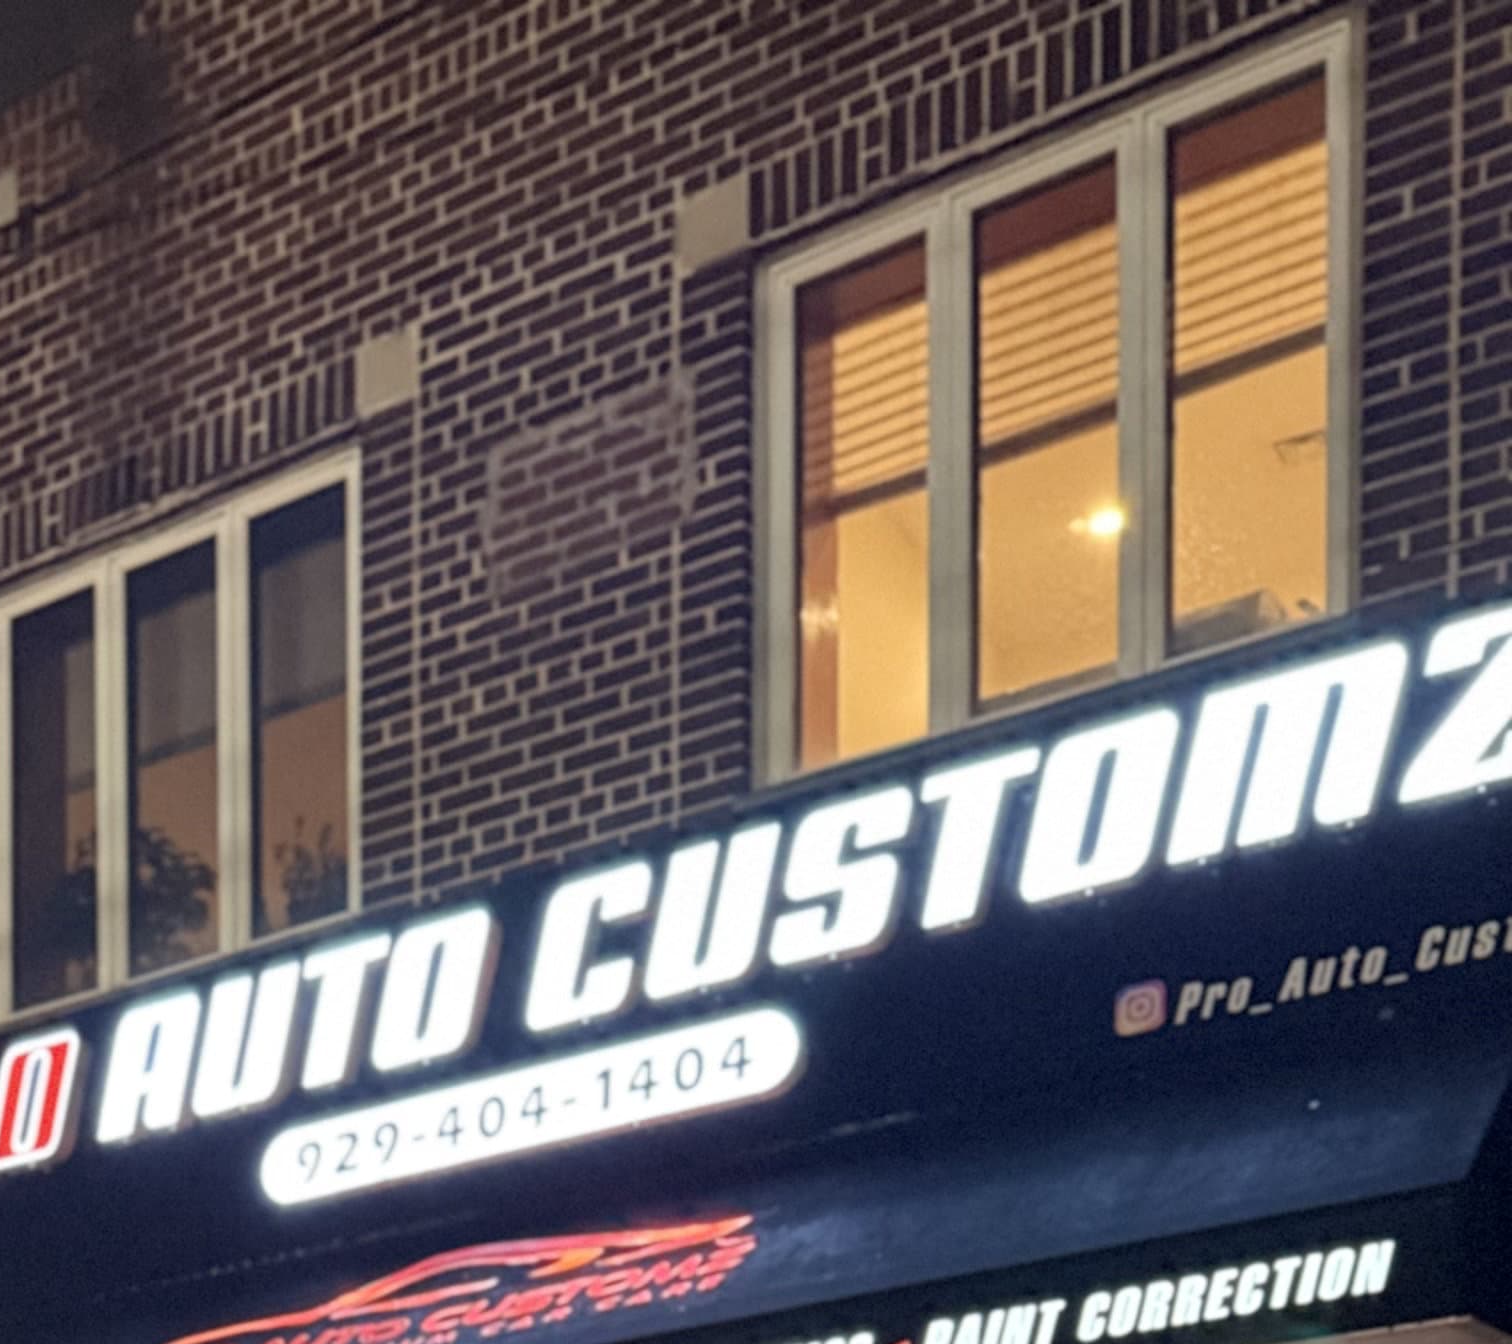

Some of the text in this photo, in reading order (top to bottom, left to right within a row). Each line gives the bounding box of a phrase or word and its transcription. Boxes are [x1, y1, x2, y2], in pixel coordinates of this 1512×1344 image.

[96, 907, 494, 1146] AUTO
[526, 605, 1512, 1031] CUSTOMZ
[297, 1036, 753, 1184] 929-404-1404
[1076, 1237, 1397, 1344] CORRECTION
